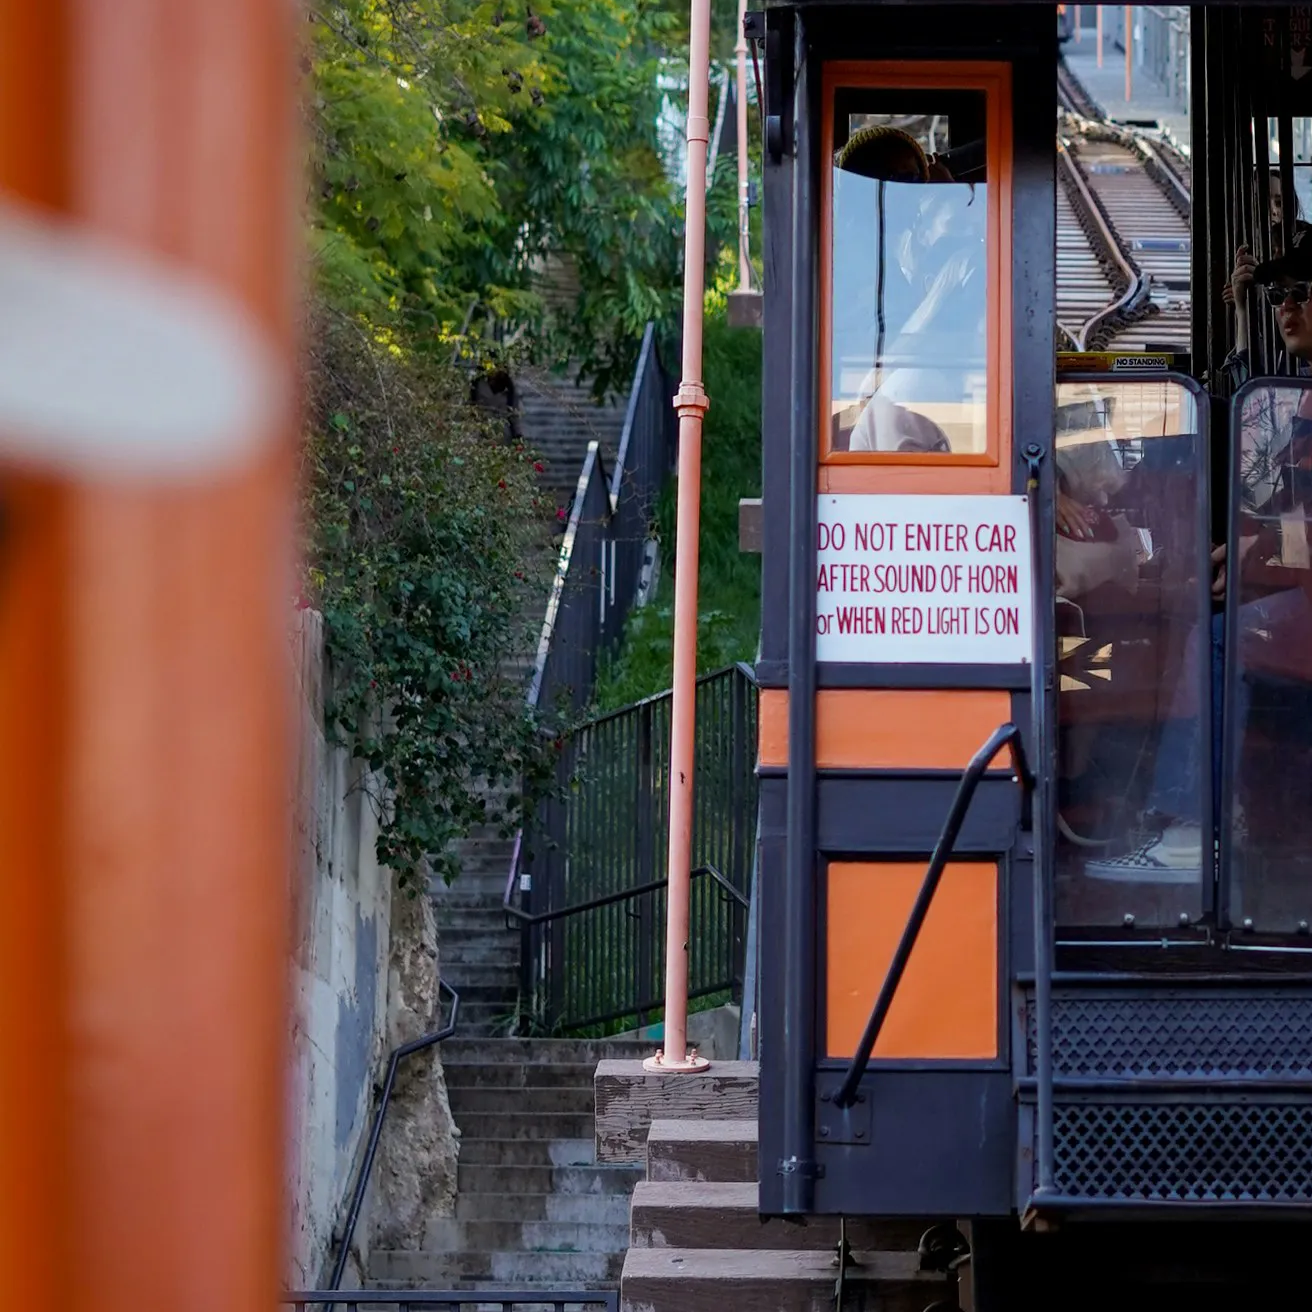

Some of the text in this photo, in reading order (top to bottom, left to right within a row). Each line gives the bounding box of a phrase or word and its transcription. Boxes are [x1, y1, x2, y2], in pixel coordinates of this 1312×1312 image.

[817, 522, 1017, 553] DO NOT ENTER CAR
[817, 564, 1018, 594] AFTER SOUND OF HORN
[816, 606, 1019, 635] or WHEN RED LIGHT IS ON
